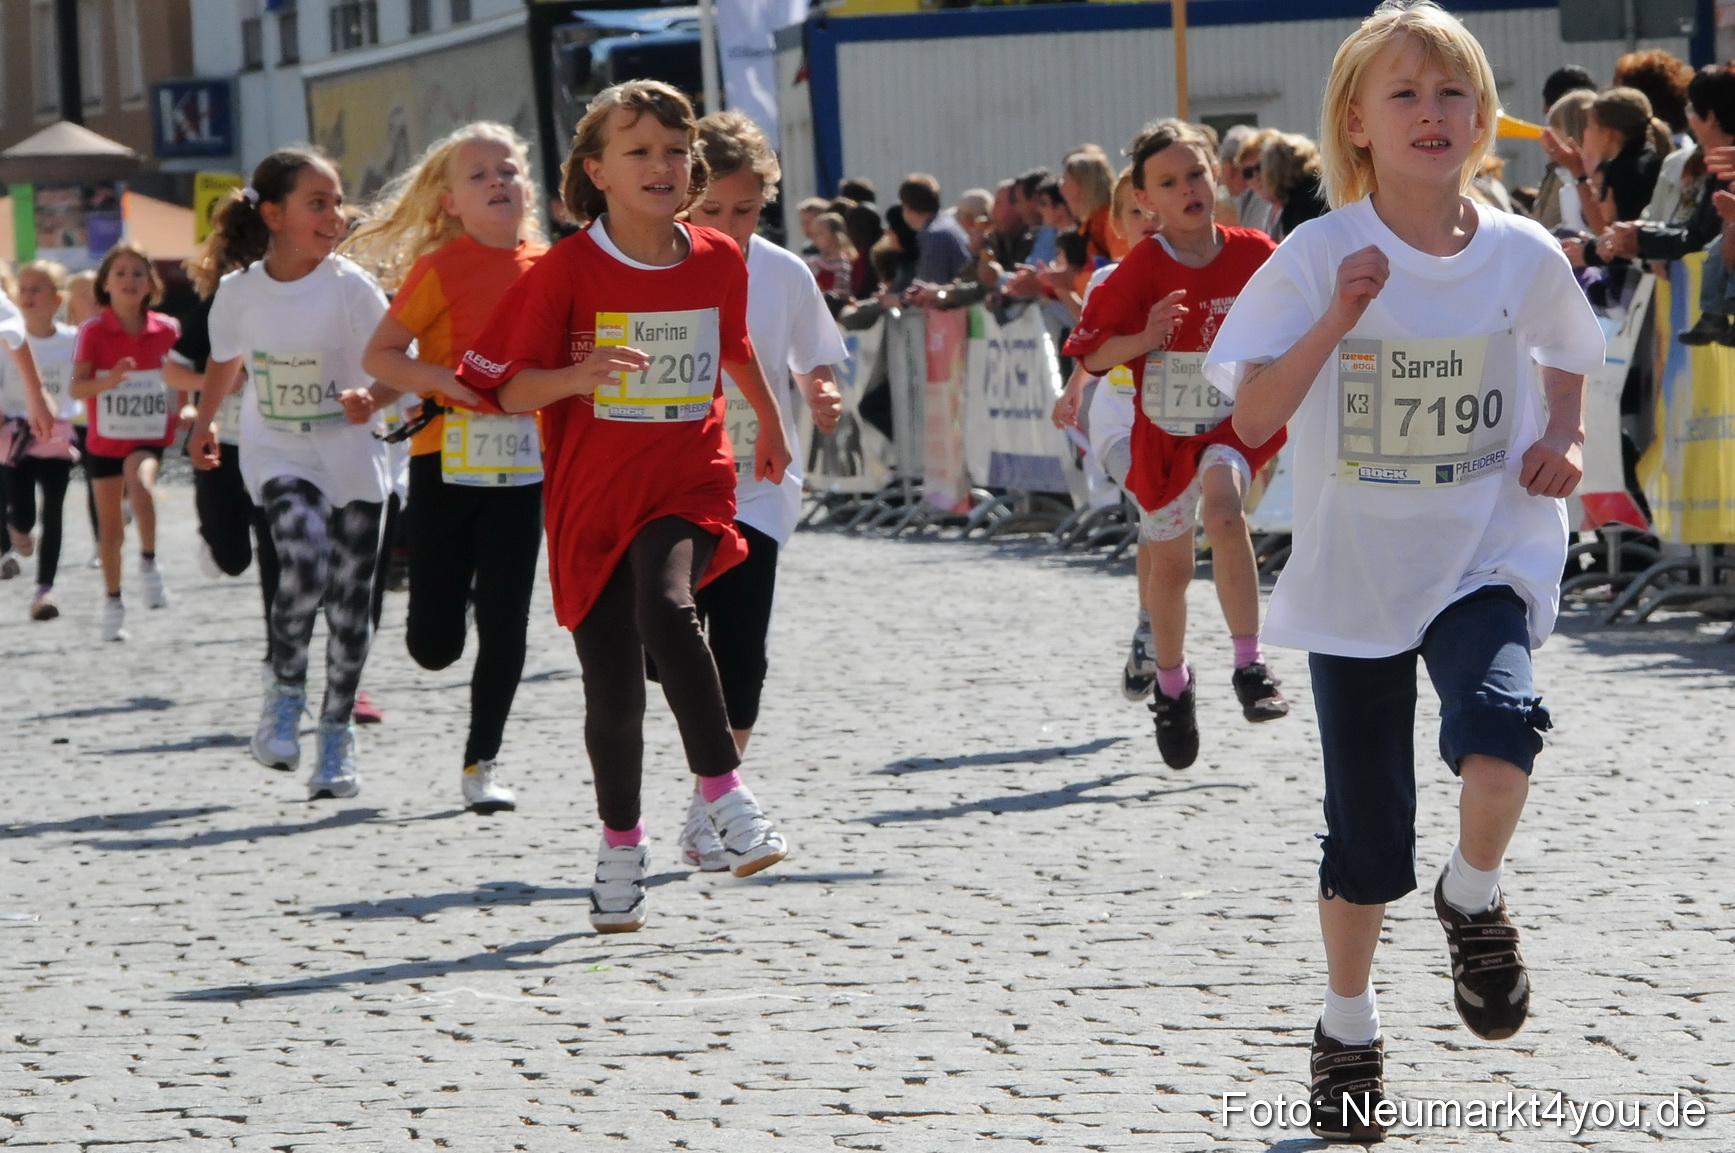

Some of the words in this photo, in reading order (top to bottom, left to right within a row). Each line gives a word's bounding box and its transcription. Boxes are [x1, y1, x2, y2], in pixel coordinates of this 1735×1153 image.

[635, 322, 687, 342] Karina
[640, 352, 711, 384] 7202
[1392, 350, 1462, 378] Sarah
[103, 393, 166, 417] 10206
[276, 380, 339, 406] 7304
[1172, 384, 1234, 408] 718
[1347, 393, 1369, 414] K3
[1394, 389, 1503, 437] 7190
[473, 433, 531, 457] 7194
[1359, 467, 1407, 480] BOCK
[1455, 449, 1506, 475] PFLEIDERER
[1333, 1055, 1362, 1063] GEOX
[1348, 1082, 1371, 1092] Sport
